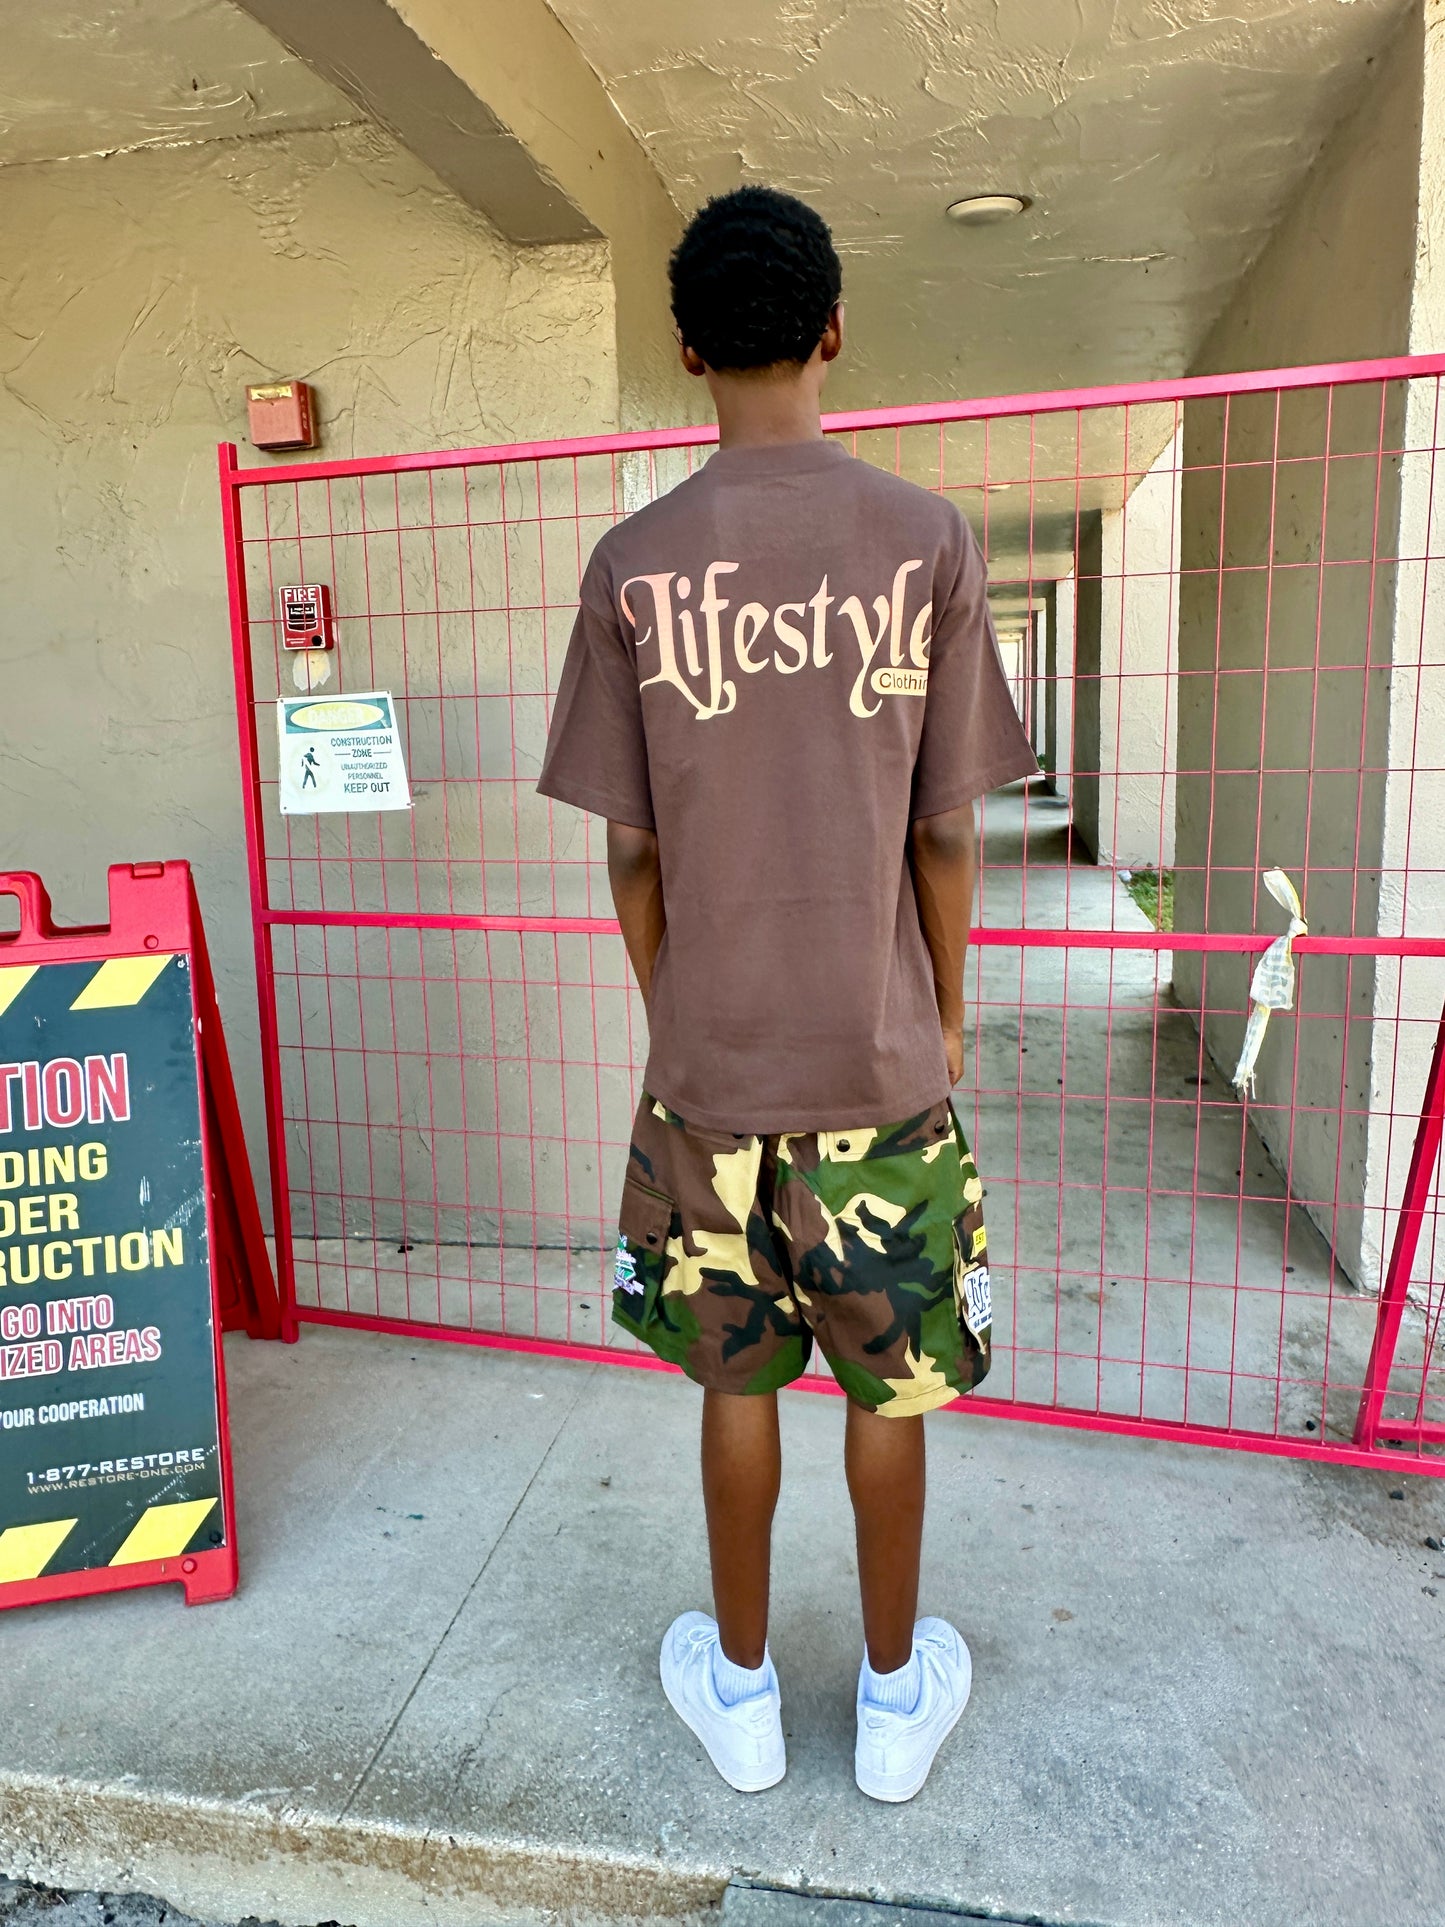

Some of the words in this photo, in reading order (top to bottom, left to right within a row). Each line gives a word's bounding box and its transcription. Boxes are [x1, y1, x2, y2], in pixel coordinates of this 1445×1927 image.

[284, 588, 317, 602] FIRE
[620, 559, 932, 720] Lifestyle
[331, 735, 393, 747] CONSTRUCTION
[352, 748, 373, 758] ZONE
[341, 761, 388, 771] UNAUTHORIZED
[347, 772, 384, 780] PERSONNEL
[344, 783, 368, 793] KEEP
[370, 782, 391, 793] OUT
[0, 1141, 108, 1190] DING
[0, 1227, 185, 1287] UCTION
[1, 1305, 41, 1340] GO
[46, 1294, 114, 1335] INTO
[68, 1326, 161, 1371] AREAS
[0, 1407, 35, 1430] OUR
[38, 1392, 145, 1424] COOPERATION
[26, 1447, 205, 1484] 1-877-RESTORE
